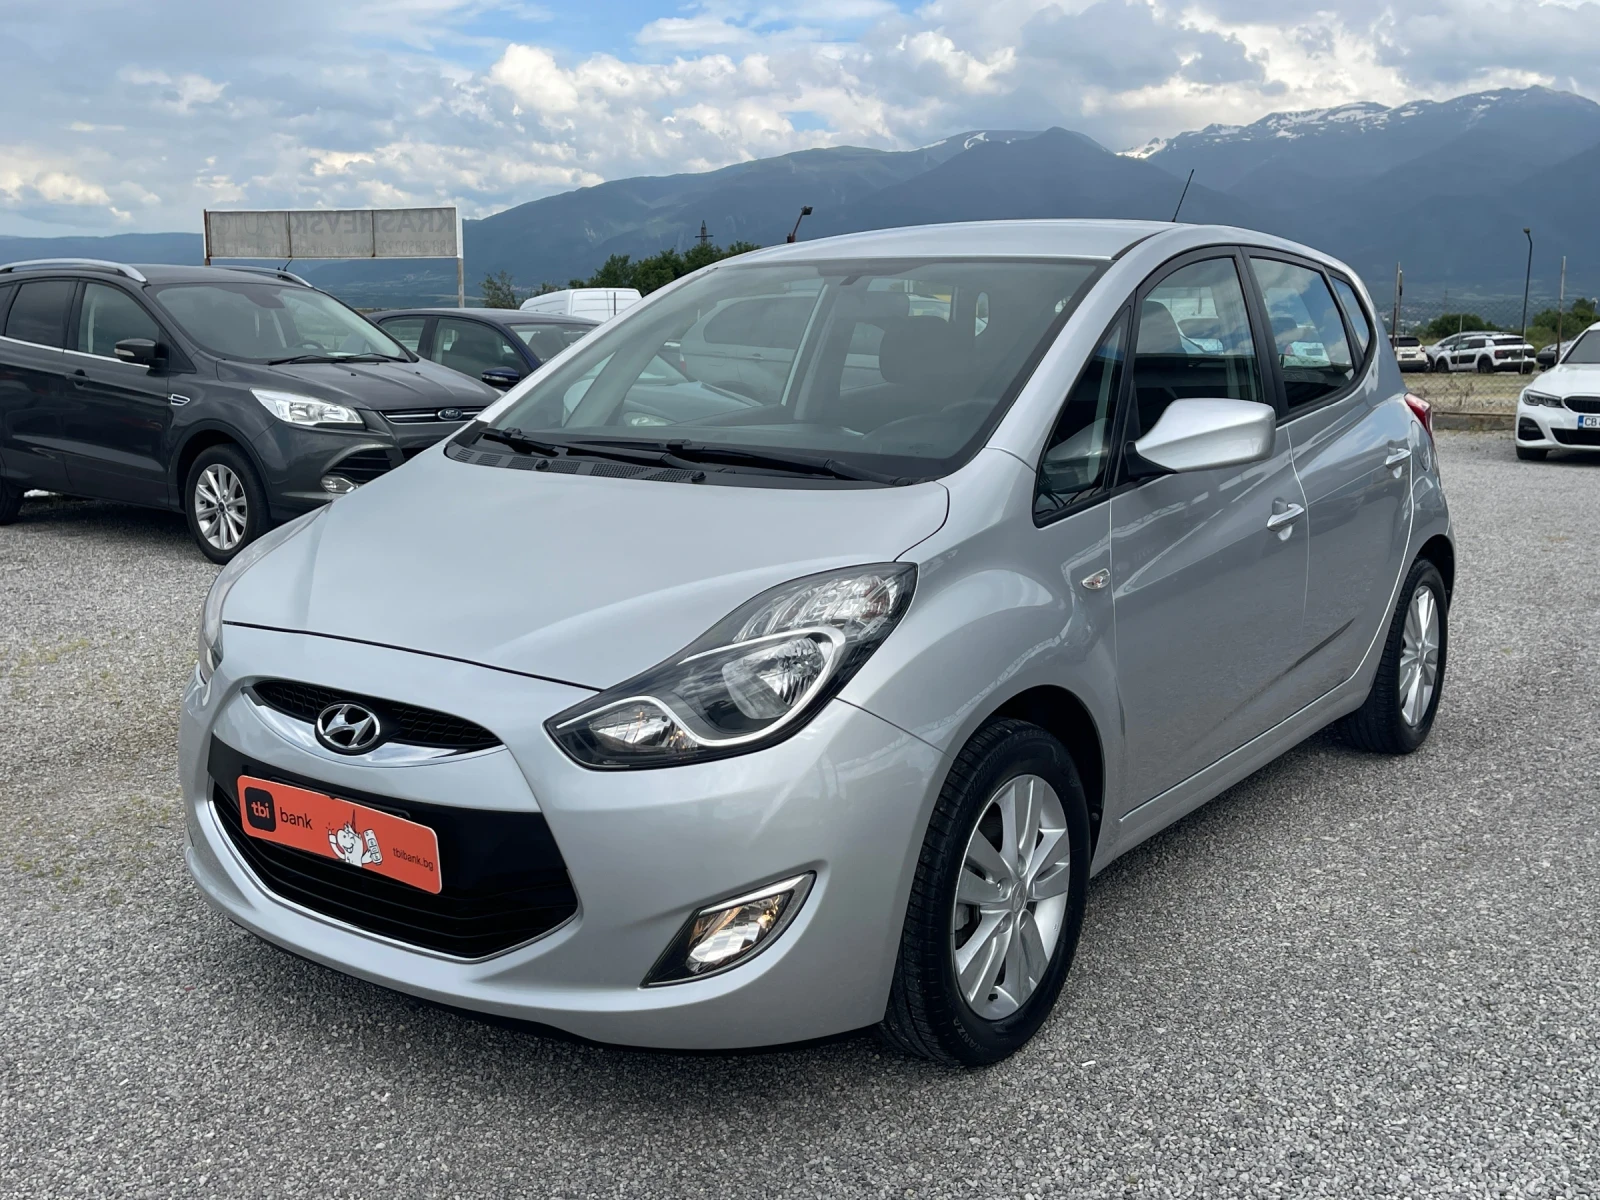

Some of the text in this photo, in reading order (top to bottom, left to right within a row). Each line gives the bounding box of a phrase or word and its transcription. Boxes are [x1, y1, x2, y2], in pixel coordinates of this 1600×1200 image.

[251, 801, 313, 830] tbi bank
[392, 847, 434, 872] tbibank.bg
[953, 1015, 991, 1053] URANZA
